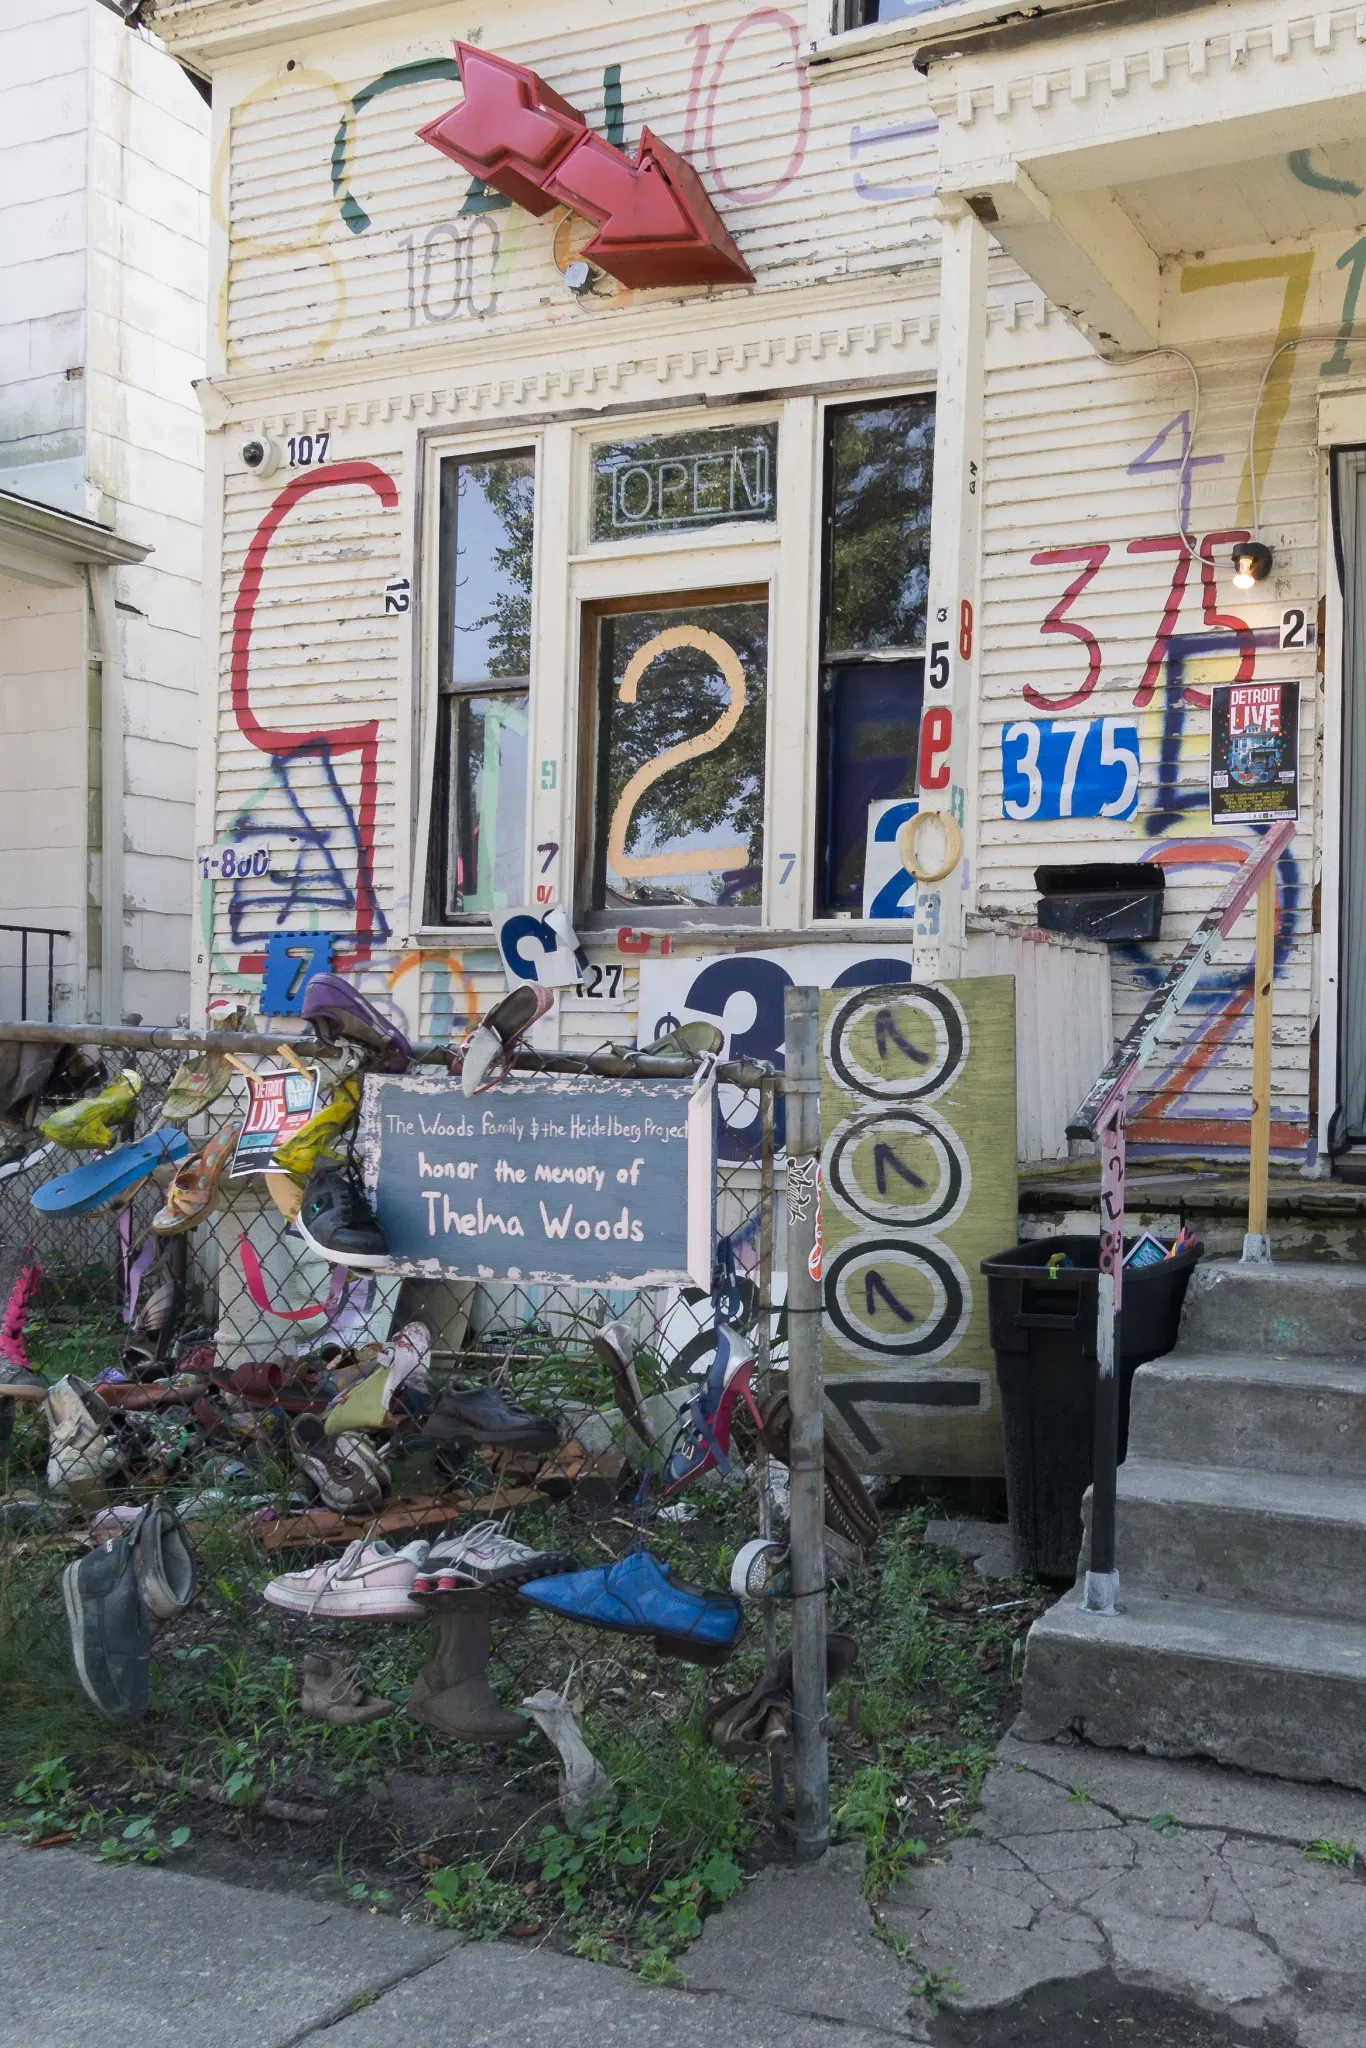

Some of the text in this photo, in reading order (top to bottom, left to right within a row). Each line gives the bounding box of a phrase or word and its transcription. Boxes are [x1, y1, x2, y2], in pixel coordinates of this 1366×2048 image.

[810, 41, 818, 53] 4
[684, 7, 811, 203] 10
[398, 214, 500, 328] 100
[287, 432, 330, 467] 107
[618, 445, 763, 520] OPEN
[1127, 410, 1225, 533] 4
[384, 578, 410, 613] 12
[936, 608, 947, 623] 3
[959, 599, 973, 661] 8
[1022, 530, 1256, 712] 375
[1283, 610, 1305, 648] 2
[929, 641, 950, 689] 5
[1231, 687, 1281, 705] DETROIT
[1230, 704, 1280, 735] LIVE
[606, 624, 750, 877] 2
[1003, 720, 1139, 821] 375
[536, 842, 559, 874] 7
[778, 852, 796, 885] 7
[253, 1079, 285, 1099] DETROIT
[246, 1099, 286, 1131] LIVE
[386, 1114, 415, 1136] The
[418, 1112, 475, 1137] Woods
[541, 1118, 567, 1138] the
[570, 1114, 642, 1143] Heidelberg
[418, 1151, 479, 1180] honor
[495, 1159, 528, 1184] the
[616, 1157, 645, 1186] of
[421, 1191, 645, 1242] Thelma Woods
